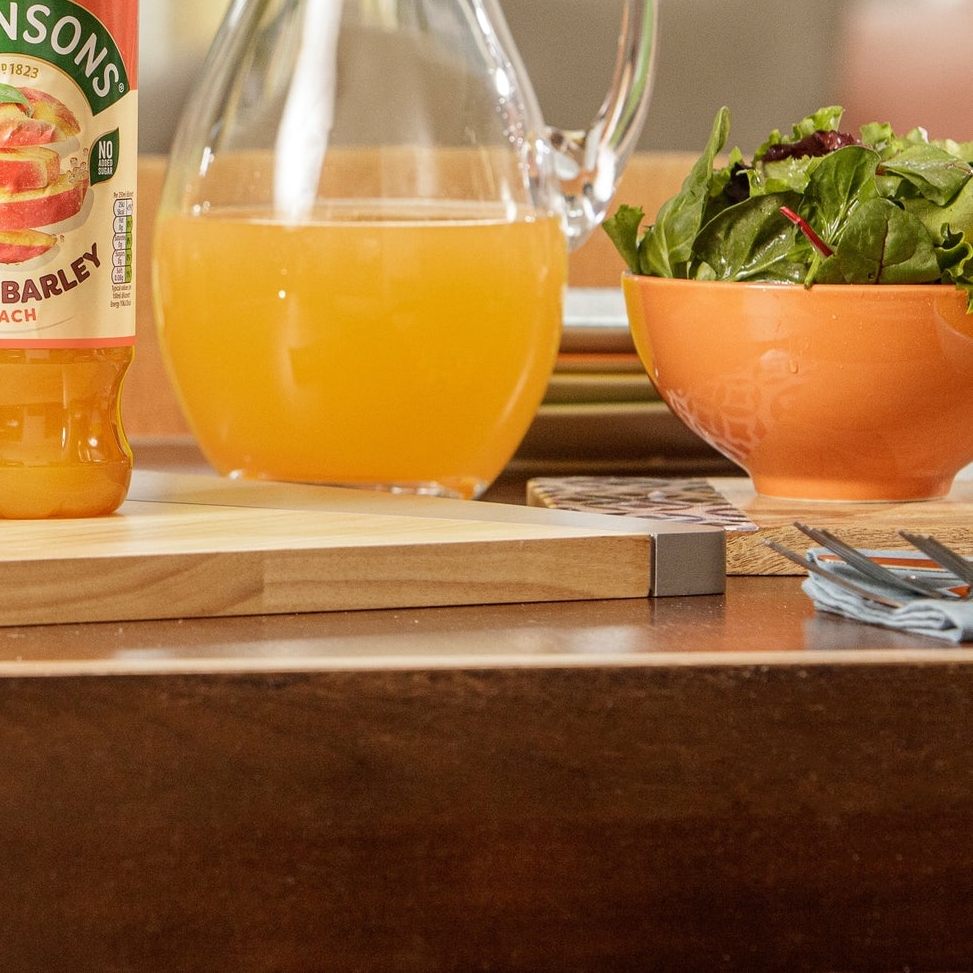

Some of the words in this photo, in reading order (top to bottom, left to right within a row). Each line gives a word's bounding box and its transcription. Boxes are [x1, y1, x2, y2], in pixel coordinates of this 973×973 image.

[10, 63, 39, 79] 1823
[98, 140, 113, 159] NO
[98, 159, 113, 167] ADDED
[98, 167, 113, 175] SUGAR
[1, 242, 102, 304] BARLEY
